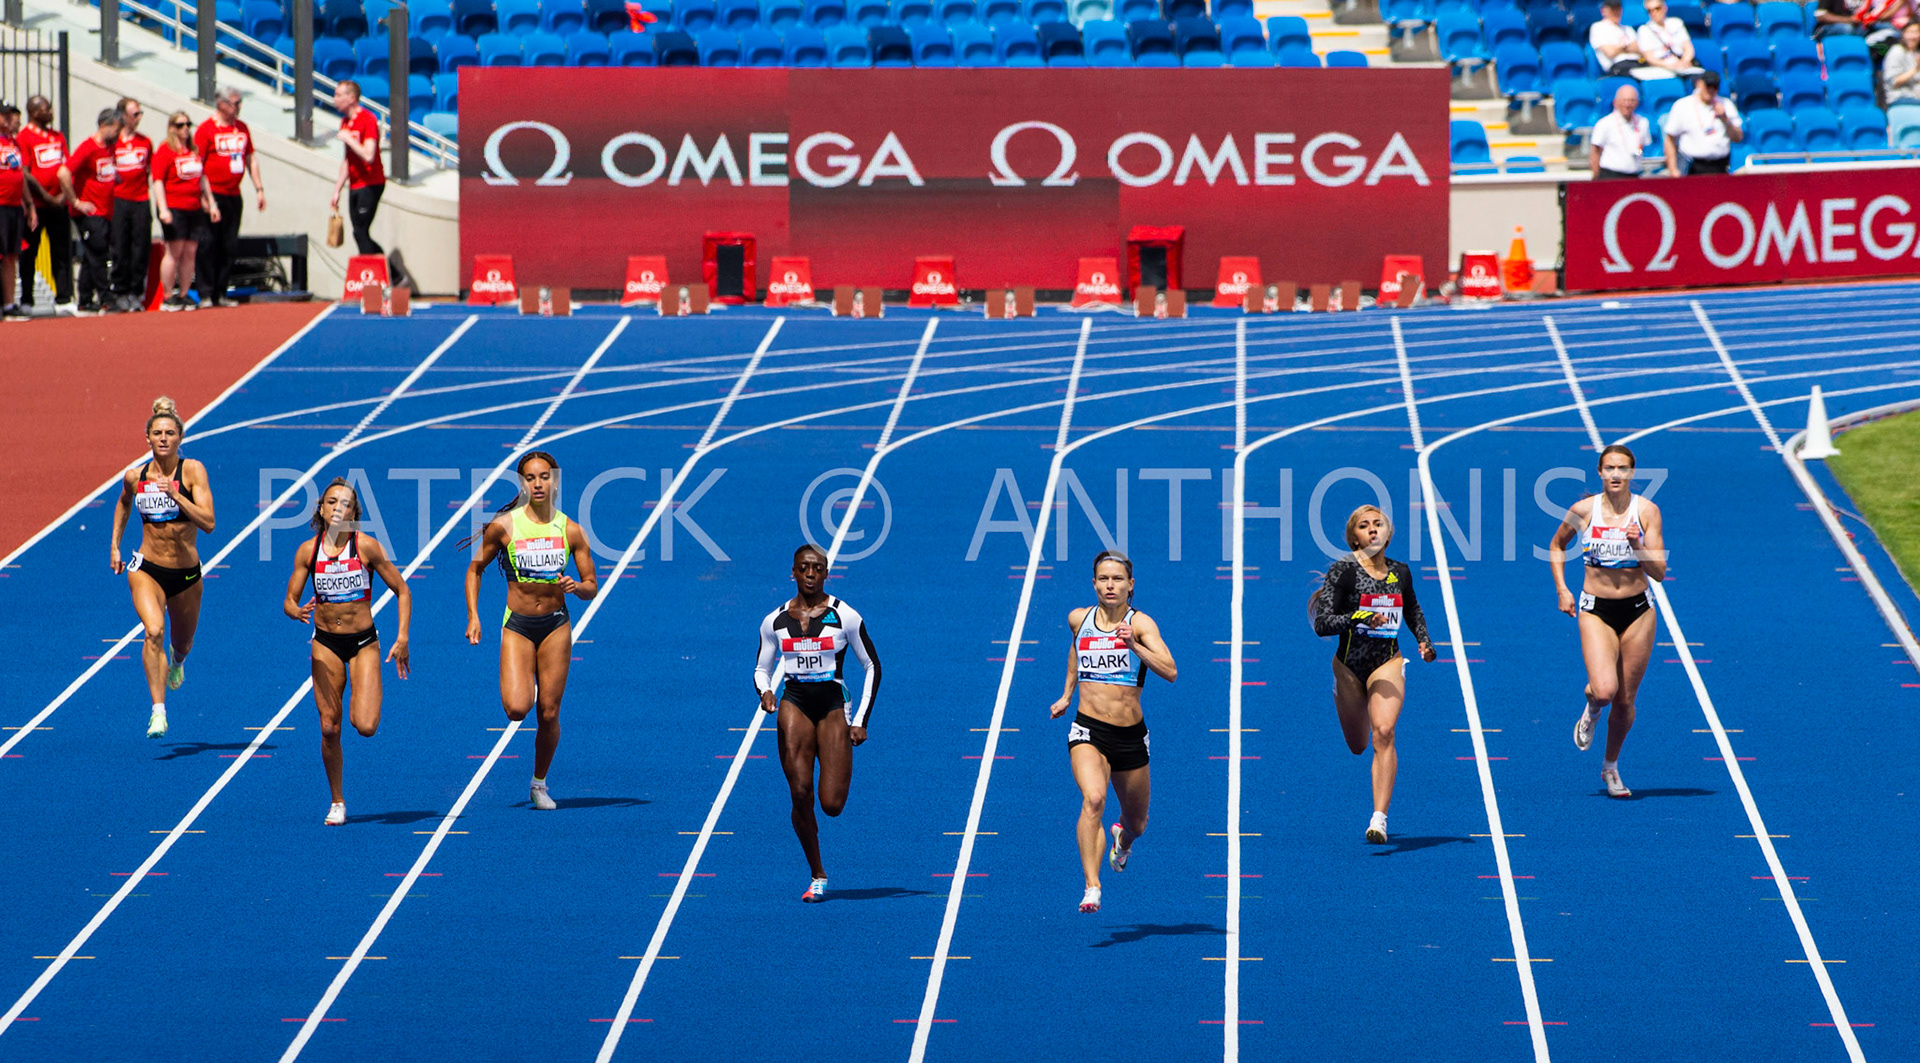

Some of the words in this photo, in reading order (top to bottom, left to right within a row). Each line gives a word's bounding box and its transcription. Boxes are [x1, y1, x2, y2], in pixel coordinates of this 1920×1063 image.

[600, 131, 925, 188] OMEGA
[1107, 131, 1431, 188] OMEGA
[1700, 194, 1920, 270] OMEG
[472, 280, 514, 293] OMEGA
[769, 281, 811, 294] OMEGA
[912, 282, 955, 295] OMEGA
[137, 496, 177, 509] HILLYARD
[1592, 543, 1634, 557] MCAULA
[517, 553, 565, 568] WILLIAMS
[316, 574, 362, 591] BECKFORD
[793, 638, 821, 651] müller
[797, 655, 823, 669] PIPI
[1081, 653, 1129, 669] CLARK
